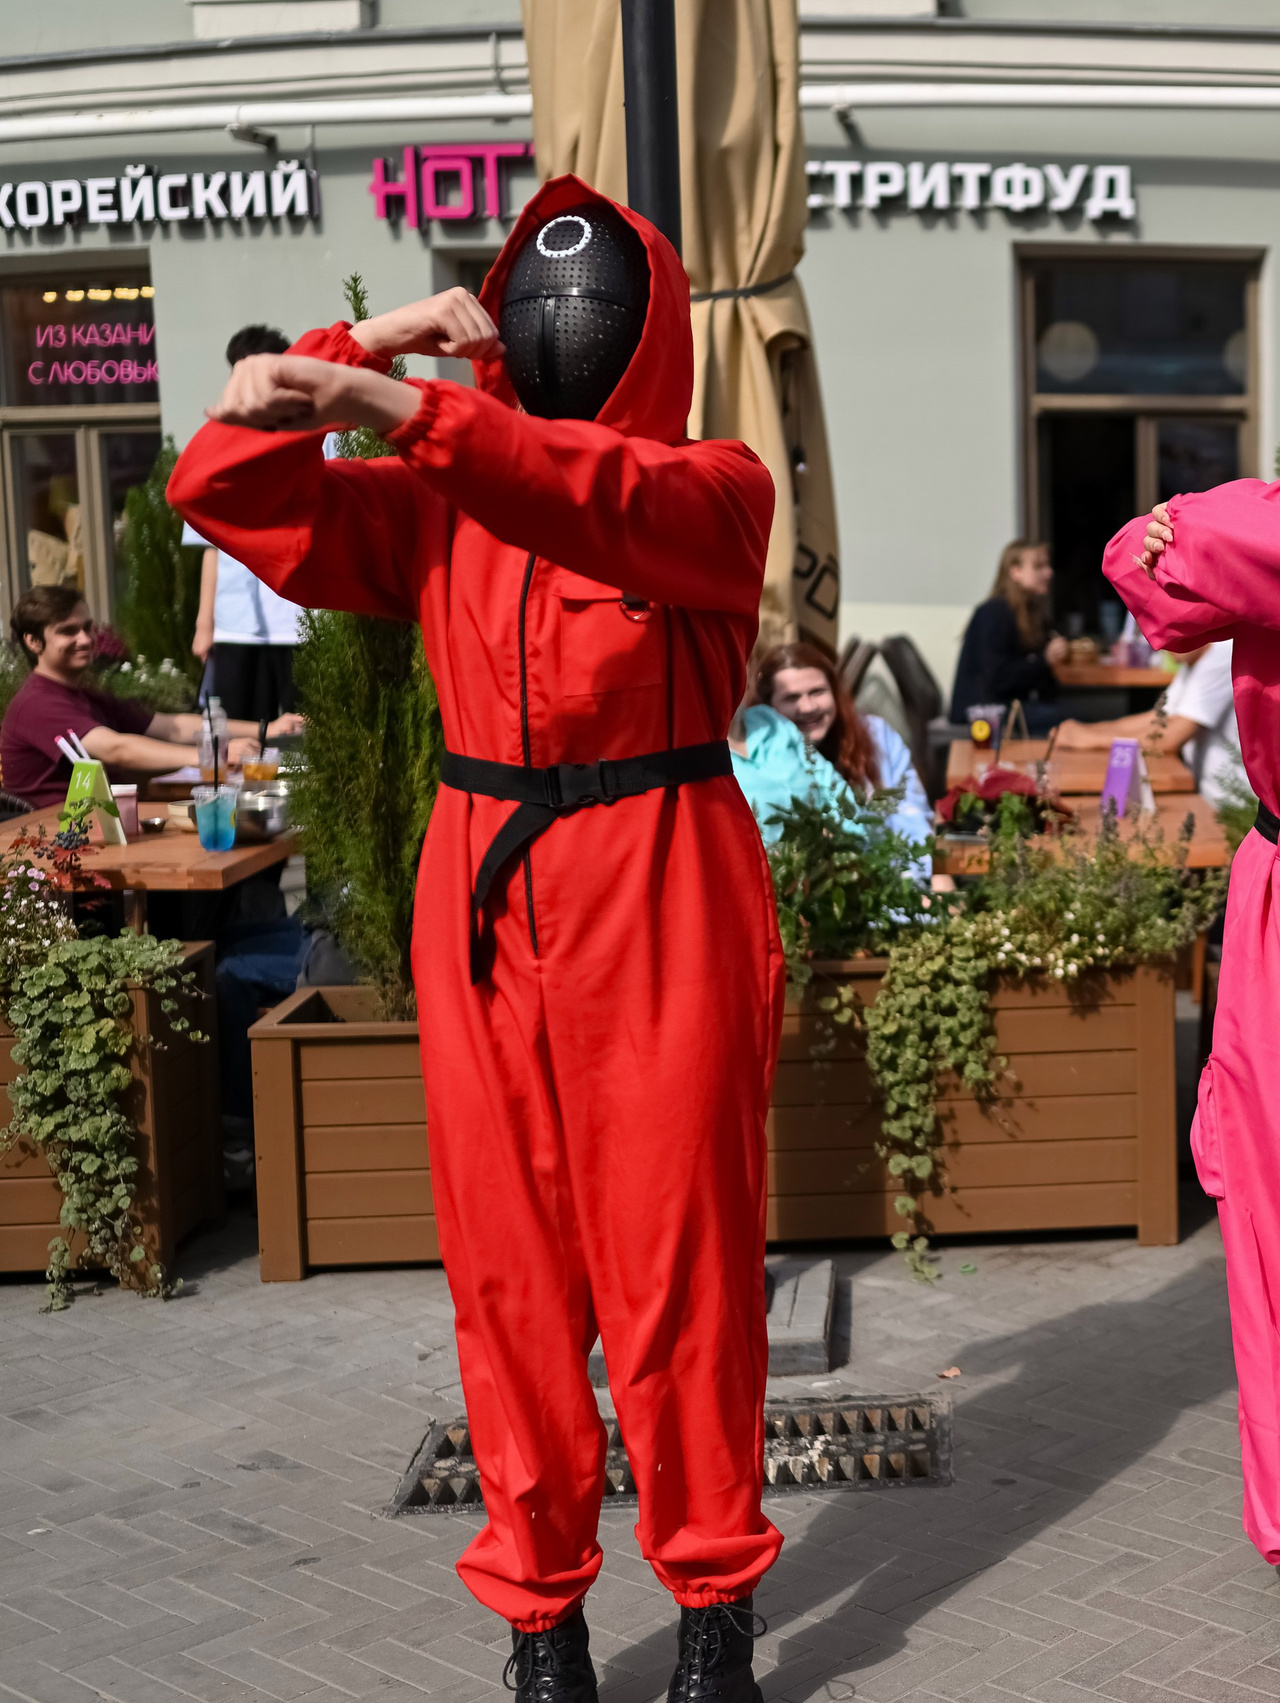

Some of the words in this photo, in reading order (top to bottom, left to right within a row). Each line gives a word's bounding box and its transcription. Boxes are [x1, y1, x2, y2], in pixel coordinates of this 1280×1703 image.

[36, 324, 67, 348] ИЗ
[28, 360, 45, 385] С
[75, 770, 92, 791] 14
